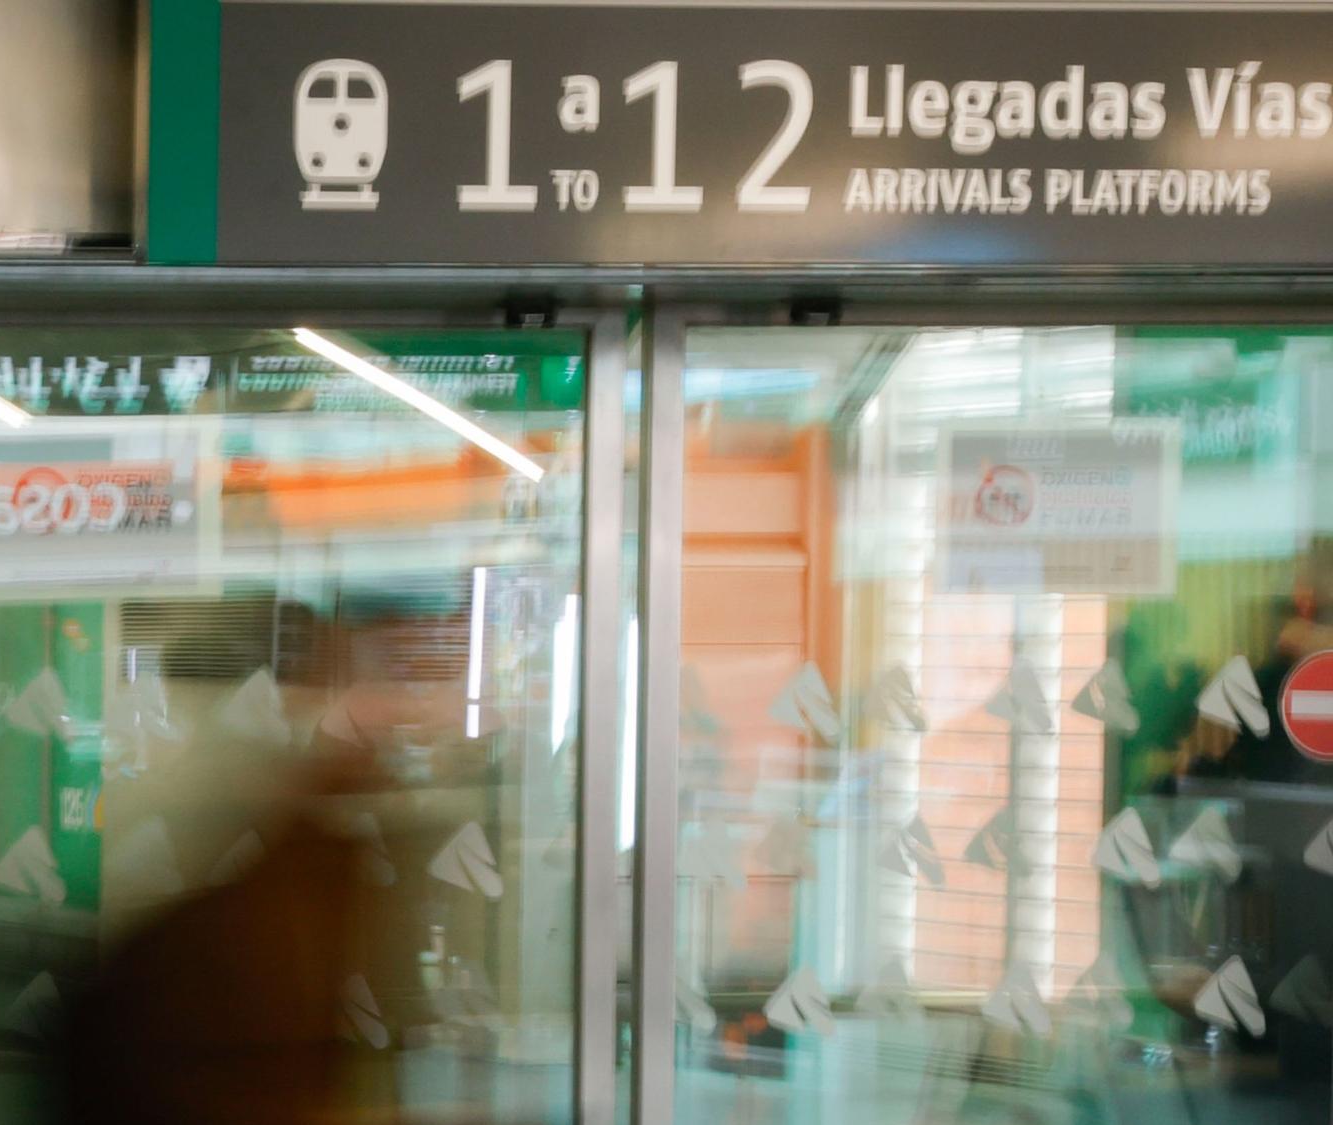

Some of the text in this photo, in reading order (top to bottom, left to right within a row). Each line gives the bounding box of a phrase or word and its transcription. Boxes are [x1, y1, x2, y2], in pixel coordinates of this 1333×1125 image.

[456, 59, 814, 213] 1 a 12
[847, 60, 1333, 156] Llegadas Vías
[549, 168, 601, 213] TO
[843, 167, 1273, 217] ARRIVALS PLATFORMS
